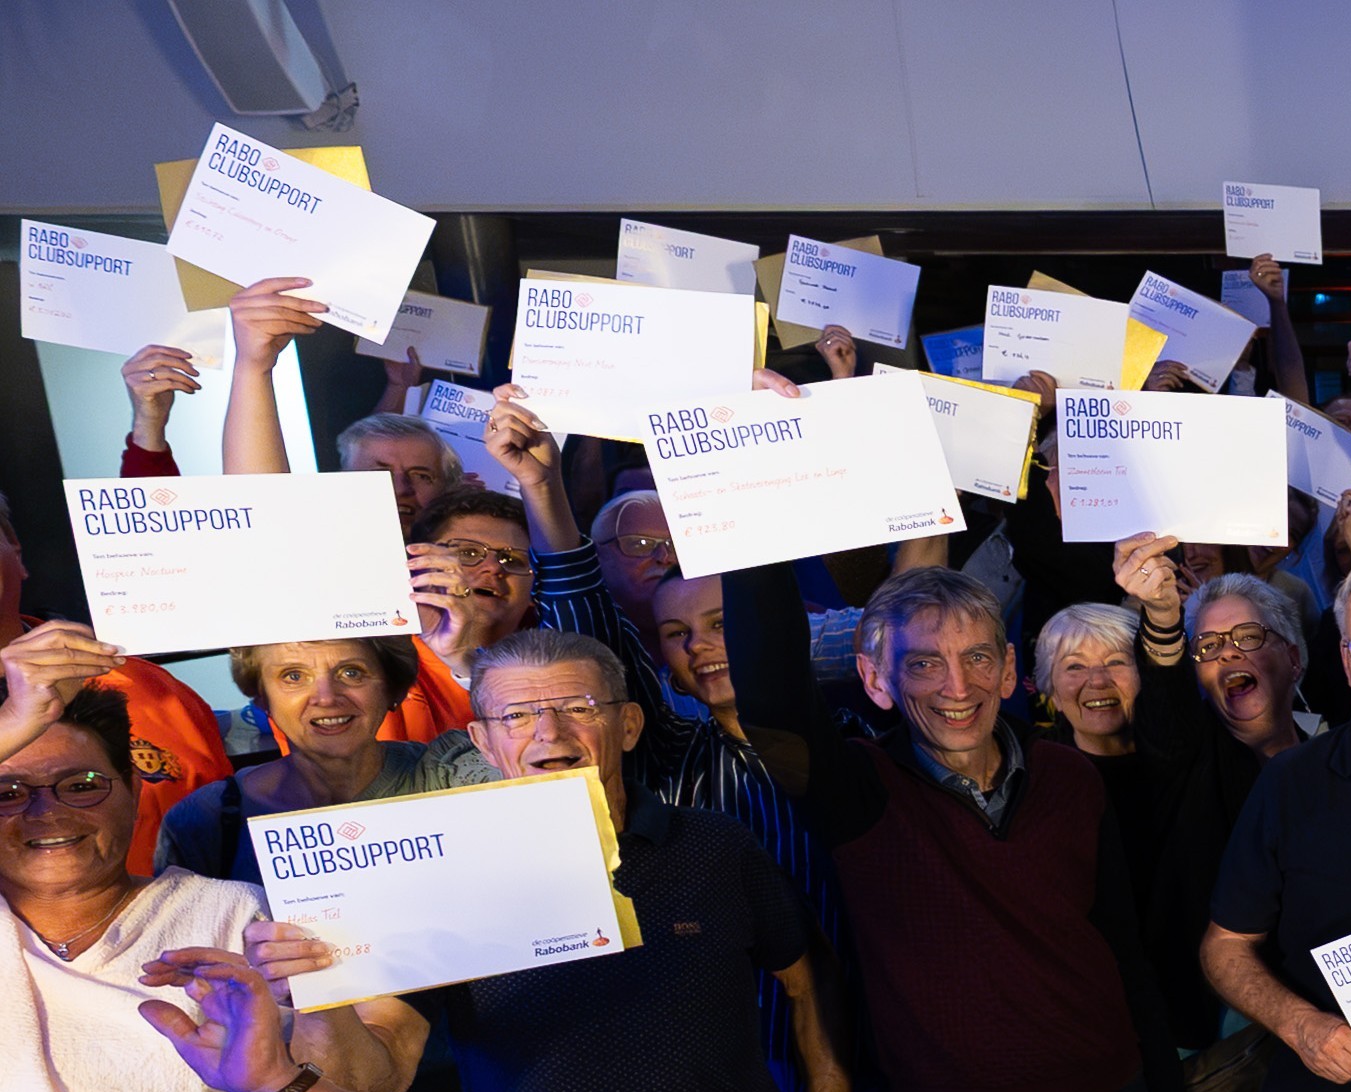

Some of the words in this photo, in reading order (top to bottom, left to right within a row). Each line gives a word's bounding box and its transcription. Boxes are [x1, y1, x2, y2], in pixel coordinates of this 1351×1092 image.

[216, 135, 262, 166] RABO
[208, 153, 322, 215] CLUBSUPPORT
[1226, 185, 1245, 196] RABO
[1227, 196, 1274, 209] CLUBSUPPORT
[29, 227, 69, 248] RABO
[792, 240, 819, 256] RABO
[28, 244, 132, 276] CLUBSUPPORT
[790, 255, 857, 277] CLUBSUPPORT
[1145, 276, 1170, 293] RABO
[527, 288, 572, 307] RABO
[992, 290, 1019, 304] RABO
[1140, 286, 1199, 319] CLUBSUPPORT
[525, 308, 645, 335] CLUBSUPPORT
[990, 304, 1061, 322] CLUBSUPPORT
[434, 385, 464, 402] RABO
[430, 397, 489, 423] CLUBSUPPO
[1065, 398, 1111, 418] RABO
[649, 407, 709, 436] RABO
[1065, 419, 1183, 441] CLUBSUPPORT
[656, 418, 803, 460] CLUBSUPPORT
[78, 488, 147, 511] RABO
[85, 507, 253, 536] CLUBSUPPORT
[888, 518, 936, 533] Rabobank
[335, 618, 388, 629] Rabobank
[265, 823, 335, 854] RABO
[272, 833, 445, 879] CLUBSUPPORT
[321, 907, 341, 920] Tiel
[534, 939, 589, 957] Rabobank
